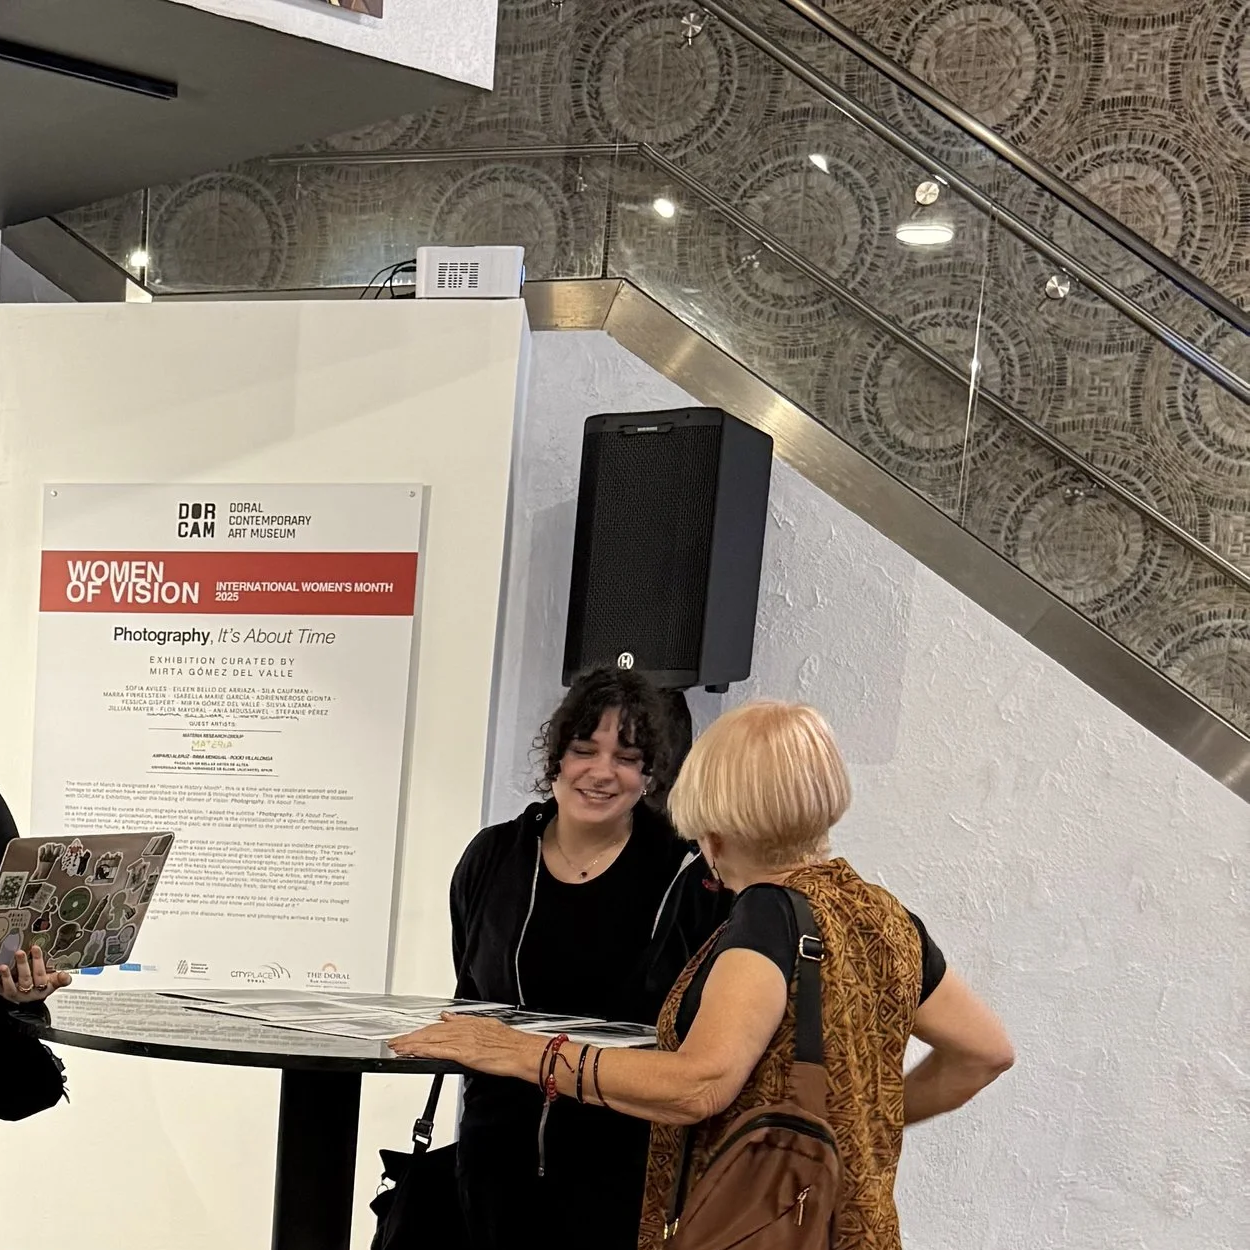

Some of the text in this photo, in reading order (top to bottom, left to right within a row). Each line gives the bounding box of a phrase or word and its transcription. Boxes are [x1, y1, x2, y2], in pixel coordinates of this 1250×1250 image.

[229, 503, 263, 512] DORAL
[229, 516, 311, 526] CONTEMPORARY
[178, 522, 215, 538] CAM
[228, 528, 295, 538] ART MUSEUM
[67, 561, 164, 583] WOMEN
[216, 581, 393, 592] INTERNATIONAL WOMEN'S MONTH
[66, 581, 199, 603] OF VISION
[215, 592, 239, 602] 2025
[114, 627, 213, 645] Photography,
[243, 629, 292, 644] About
[298, 630, 335, 644] Time
[150, 656, 215, 664] EXHIBITION
[188, 667, 228, 676] GÓMEZ
[259, 669, 293, 677] VALLE
